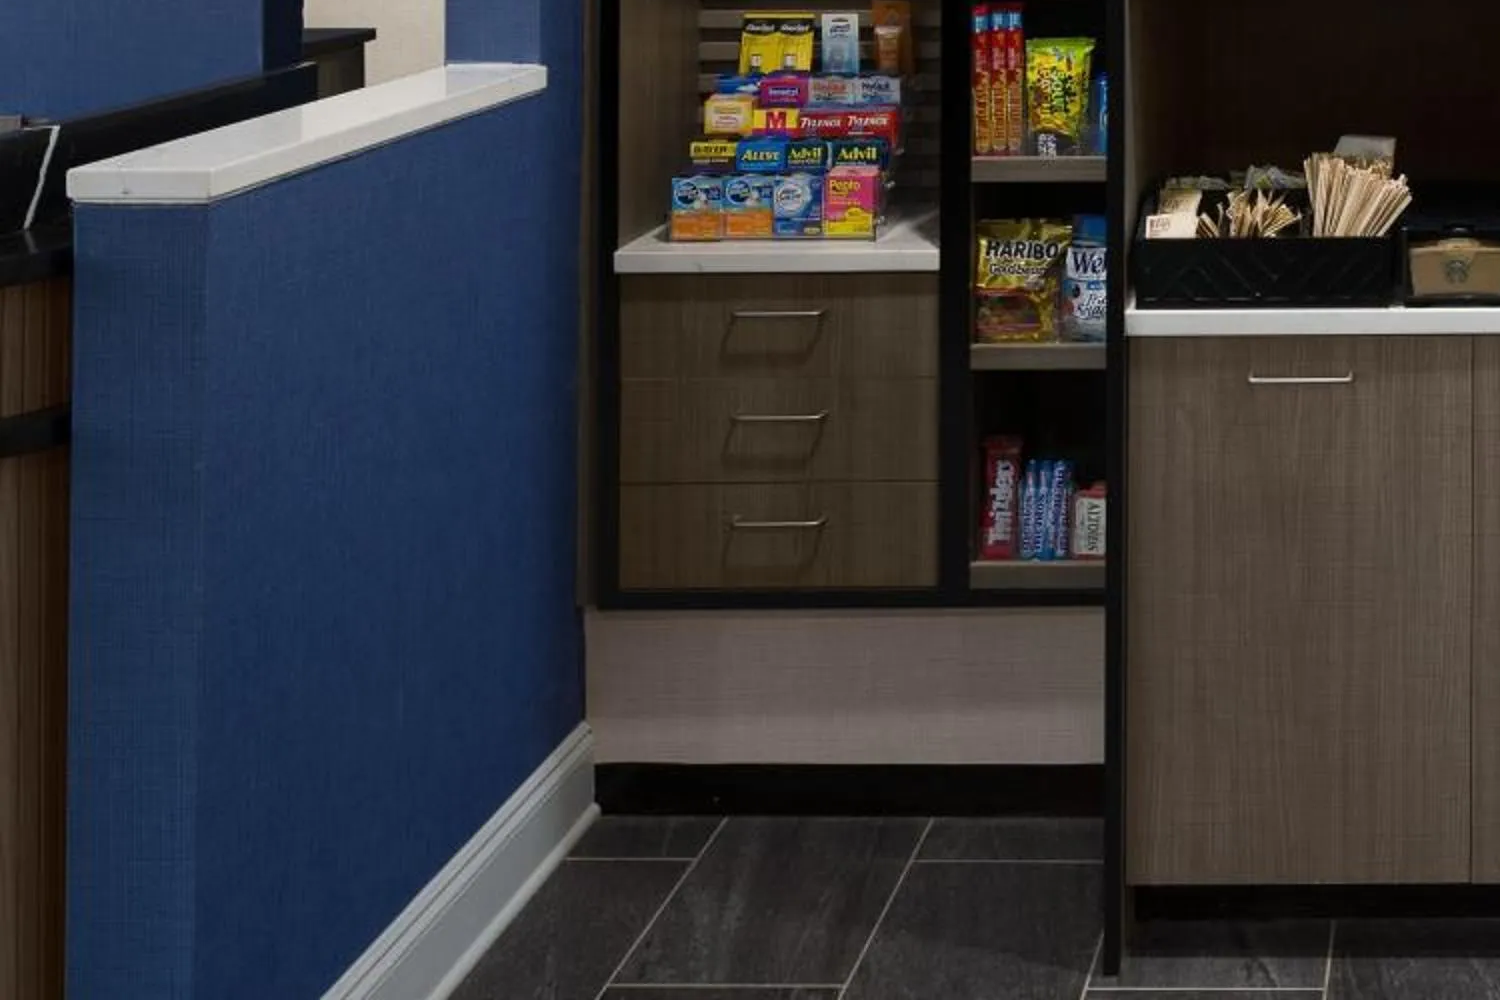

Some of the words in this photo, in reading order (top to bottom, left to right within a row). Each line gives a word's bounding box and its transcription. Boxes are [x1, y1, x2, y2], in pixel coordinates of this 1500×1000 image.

[766, 111, 788, 130] M
[788, 146, 823, 160] Advil
[837, 146, 877, 160] Advil
[986, 239, 1060, 261] HARIBO
